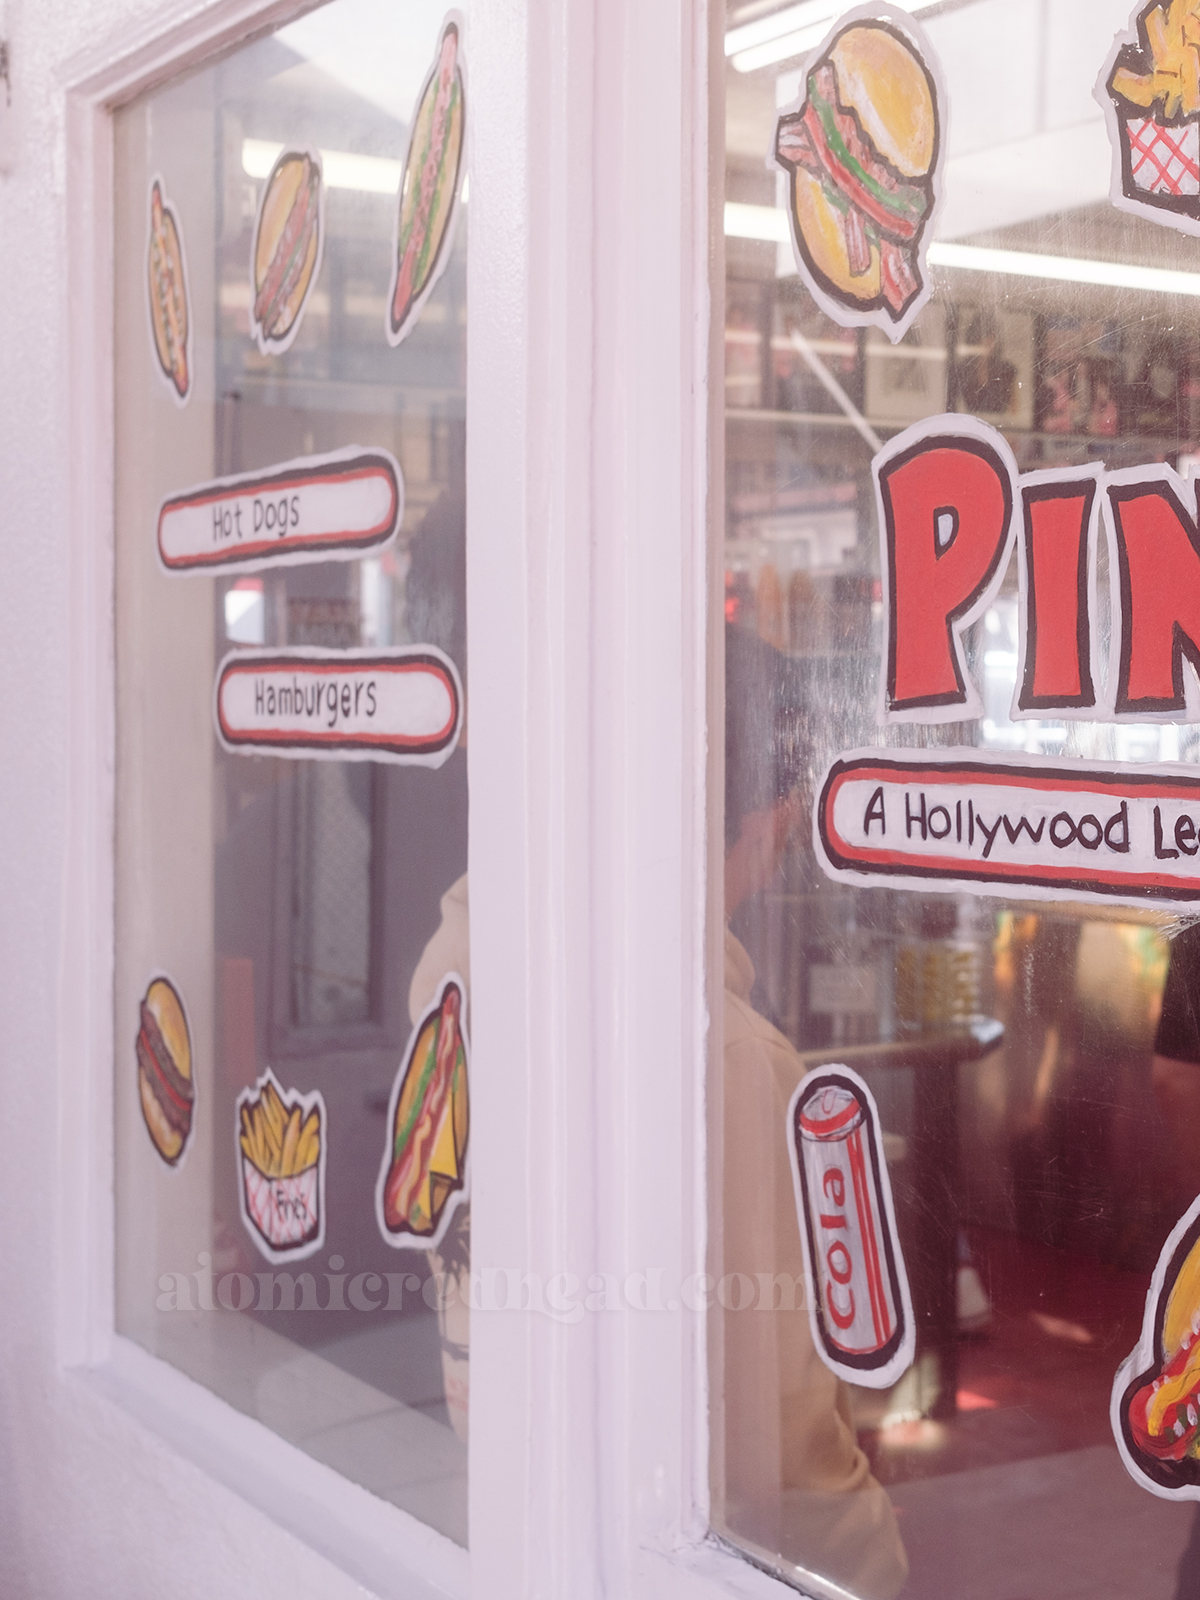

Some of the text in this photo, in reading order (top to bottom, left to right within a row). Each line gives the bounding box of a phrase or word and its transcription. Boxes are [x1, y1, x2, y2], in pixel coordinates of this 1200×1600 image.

[213, 496, 300, 542] Hot Dogs
[255, 677, 377, 727] Hamburgers
[863, 786, 886, 836] A
[904, 792, 1131, 860] Hollywood
